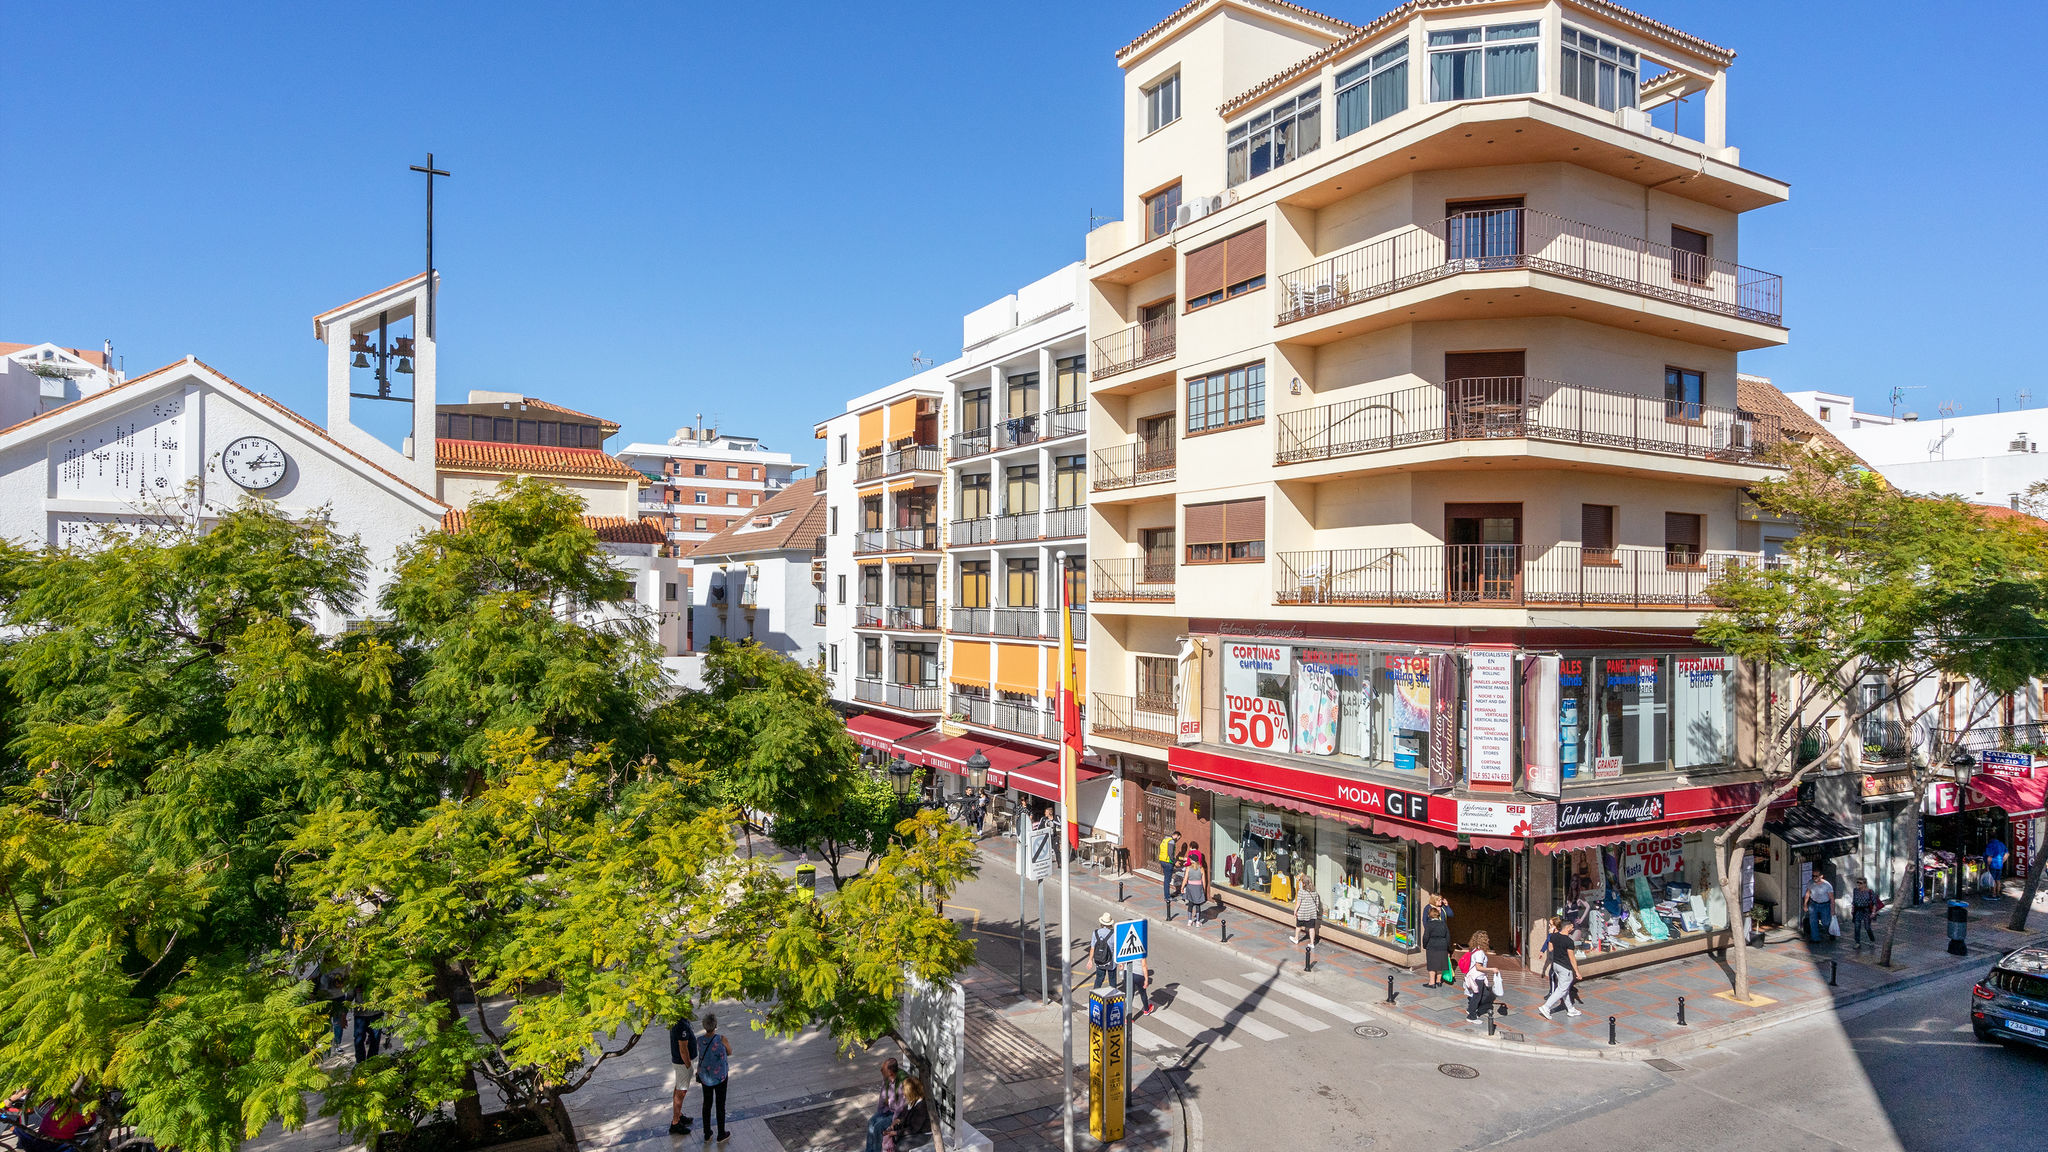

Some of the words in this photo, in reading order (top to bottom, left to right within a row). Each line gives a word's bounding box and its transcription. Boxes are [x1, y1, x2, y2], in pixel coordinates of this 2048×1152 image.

[1233, 646, 1280, 661] CORTINAS
[1303, 649, 1358, 666] ENROLLABLES
[1240, 660, 1272, 671] curtains
[1303, 663, 1327, 674] roller
[1330, 664, 1358, 677] blinds
[1385, 655, 1429, 670] ESTOR
[1560, 660, 1582, 674] ALES
[1607, 659, 1627, 673] PANEL
[1679, 658, 1725, 673] PERSIANAS
[1385, 669, 1413, 685] rolling
[1416, 671, 1429, 683] shu
[1690, 670, 1714, 682] blinds
[1226, 695, 1263, 713] TODO
[1268, 700, 1285, 716] AL
[1228, 711, 1288, 748] 50%
[1986, 751, 2029, 760] CALZADOS
[1987, 764, 2027, 773] FACTORY
[1994, 769, 2020, 777] PRICE
[1338, 785, 1380, 807] MODA
[1940, 787, 1987, 809] FAC
[1560, 805, 1601, 828] Galerías
[1626, 837, 1683, 857] LOCOS
[1641, 852, 1671, 876] 70%
[2016, 845, 2026, 877] PRICE
[1364, 863, 1395, 880] OFFERTS
[1093, 1032, 1101, 1063] TAXI
[1110, 1034, 1120, 1066] TAXI
